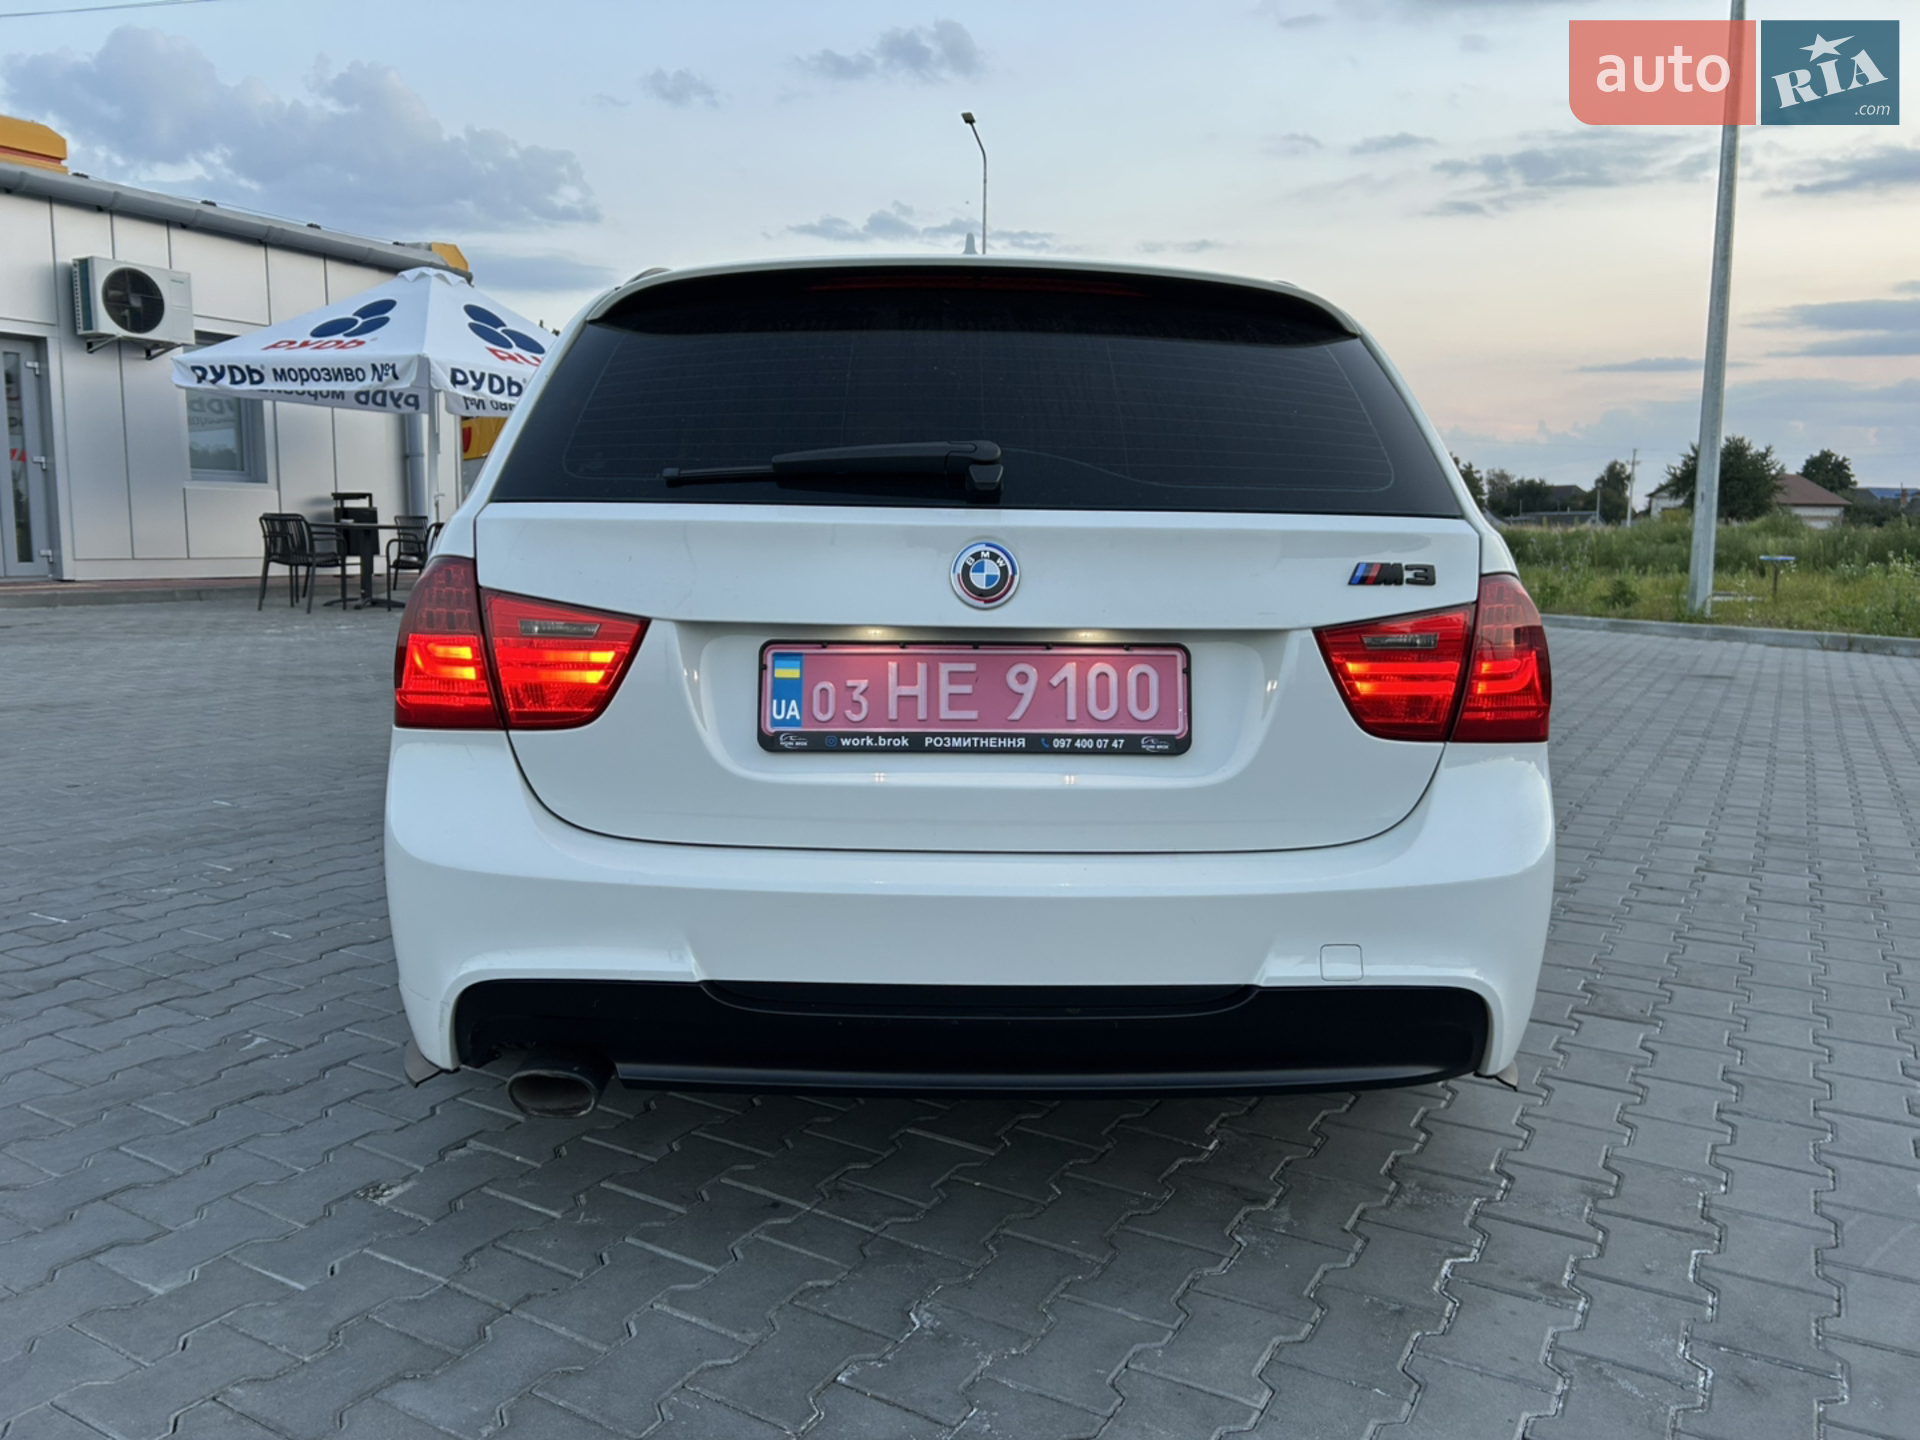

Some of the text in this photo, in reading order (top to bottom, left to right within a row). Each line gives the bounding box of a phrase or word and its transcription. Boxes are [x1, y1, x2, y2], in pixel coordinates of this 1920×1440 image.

[272, 366, 366, 386] морозиво
[965, 551, 1006, 568] BMW
[812, 680, 869, 722] 03
[1006, 661, 1160, 721] 9100
[772, 699, 800, 720] UA
[840, 735, 909, 747] work.brok
[925, 736, 1026, 748] РОЗМИТНЕННЯ
[1052, 738, 1125, 749] 097 400 07 47
